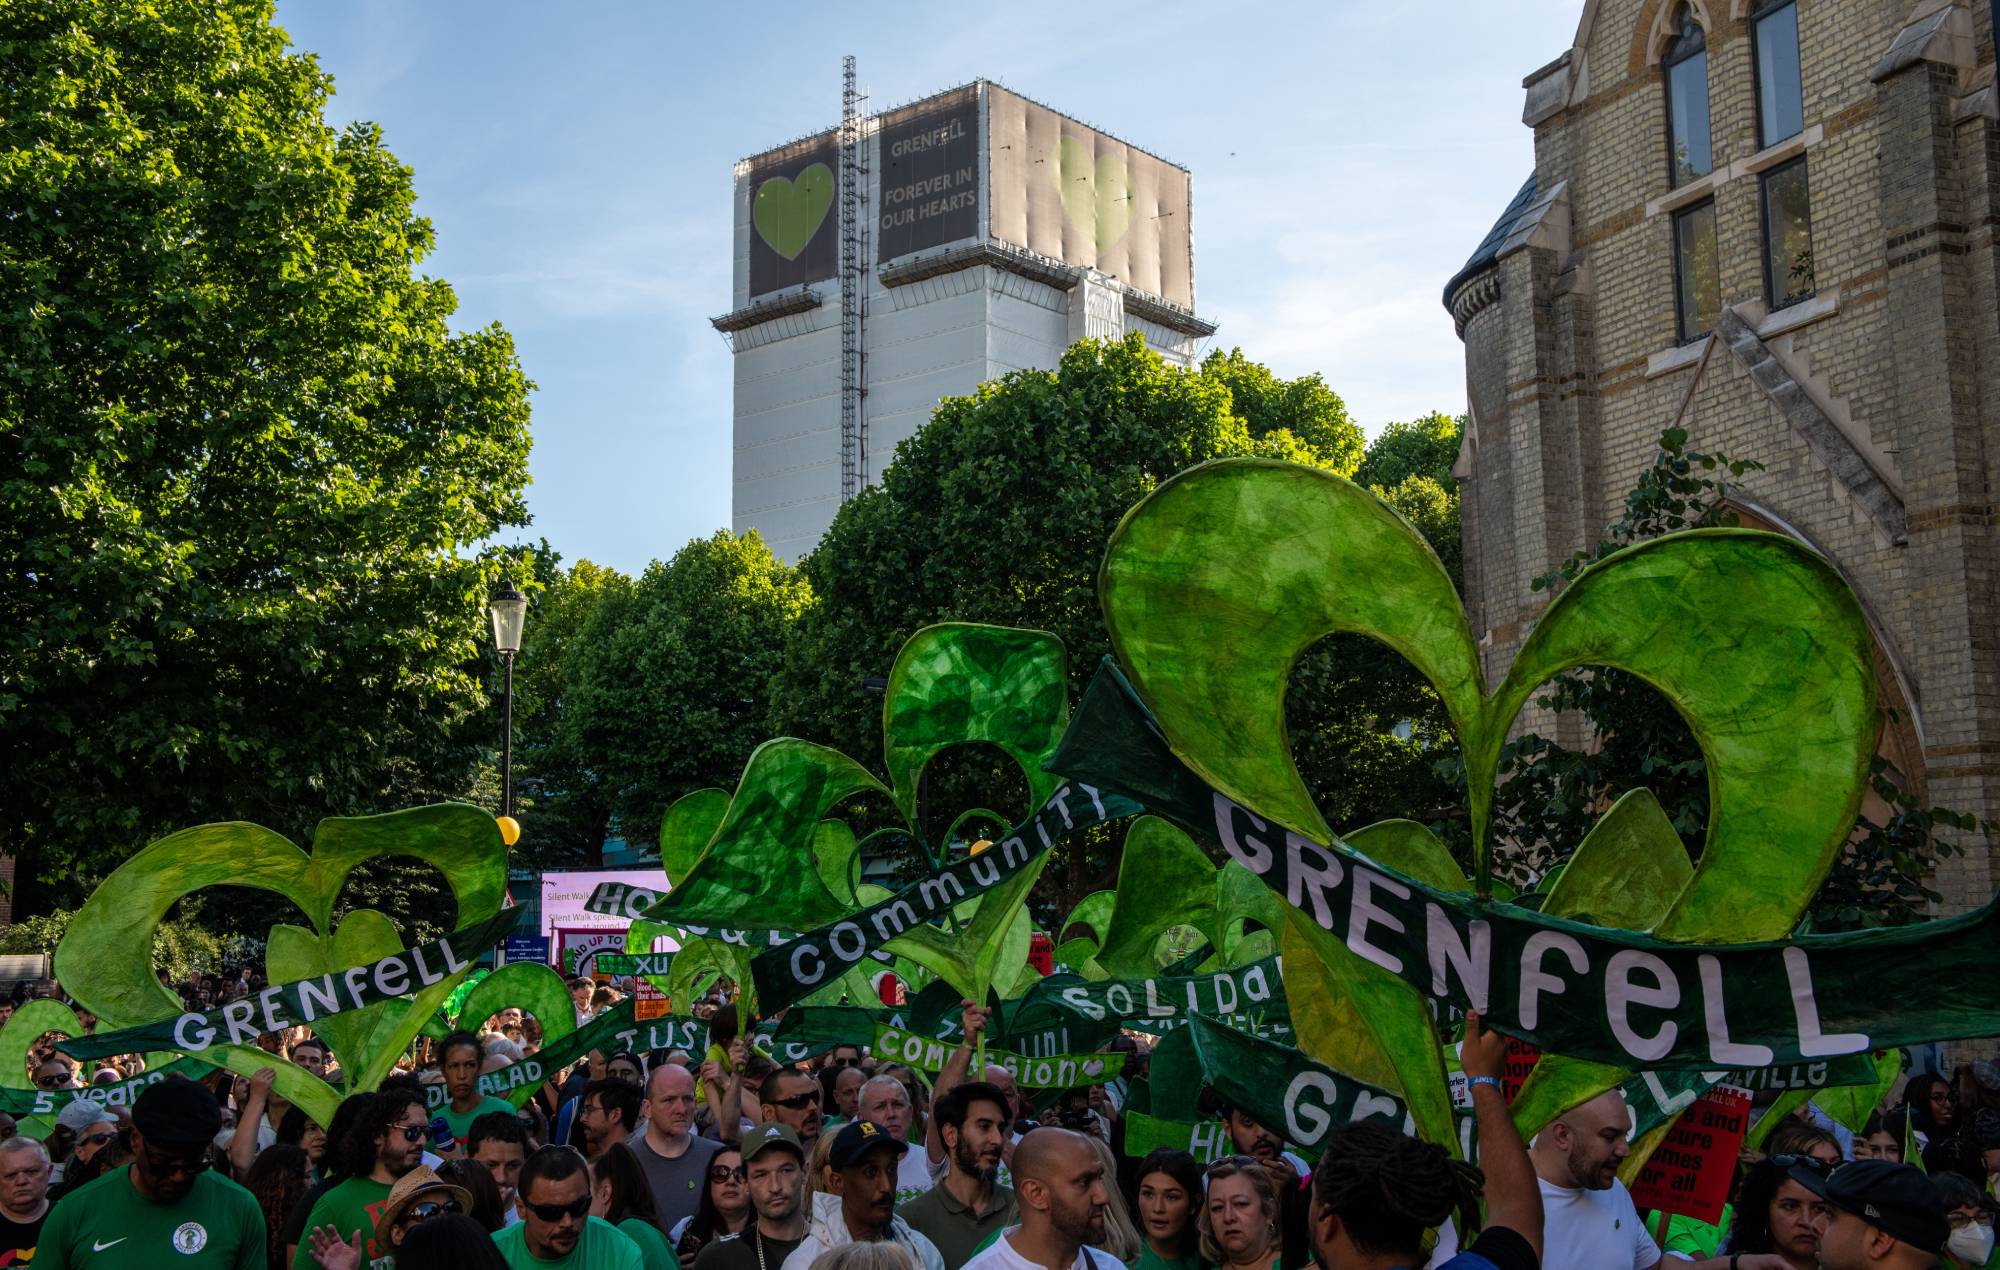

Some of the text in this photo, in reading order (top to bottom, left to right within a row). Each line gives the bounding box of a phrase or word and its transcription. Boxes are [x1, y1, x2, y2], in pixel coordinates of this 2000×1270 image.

[891, 118, 967, 158] GRENFELL
[885, 167, 972, 206] FOREVER IN
[881, 190, 976, 230] OUR HEARTS
[547, 891, 570, 901] Silent
[549, 913, 571, 922] Silent
[573, 912, 591, 921] Walk
[588, 936, 604, 947] UP
[607, 935, 623, 945] TO
[32, 1090, 56, 1114] 5
[1702, 1110, 1743, 1134] and
[1671, 1173, 1696, 1193] all
